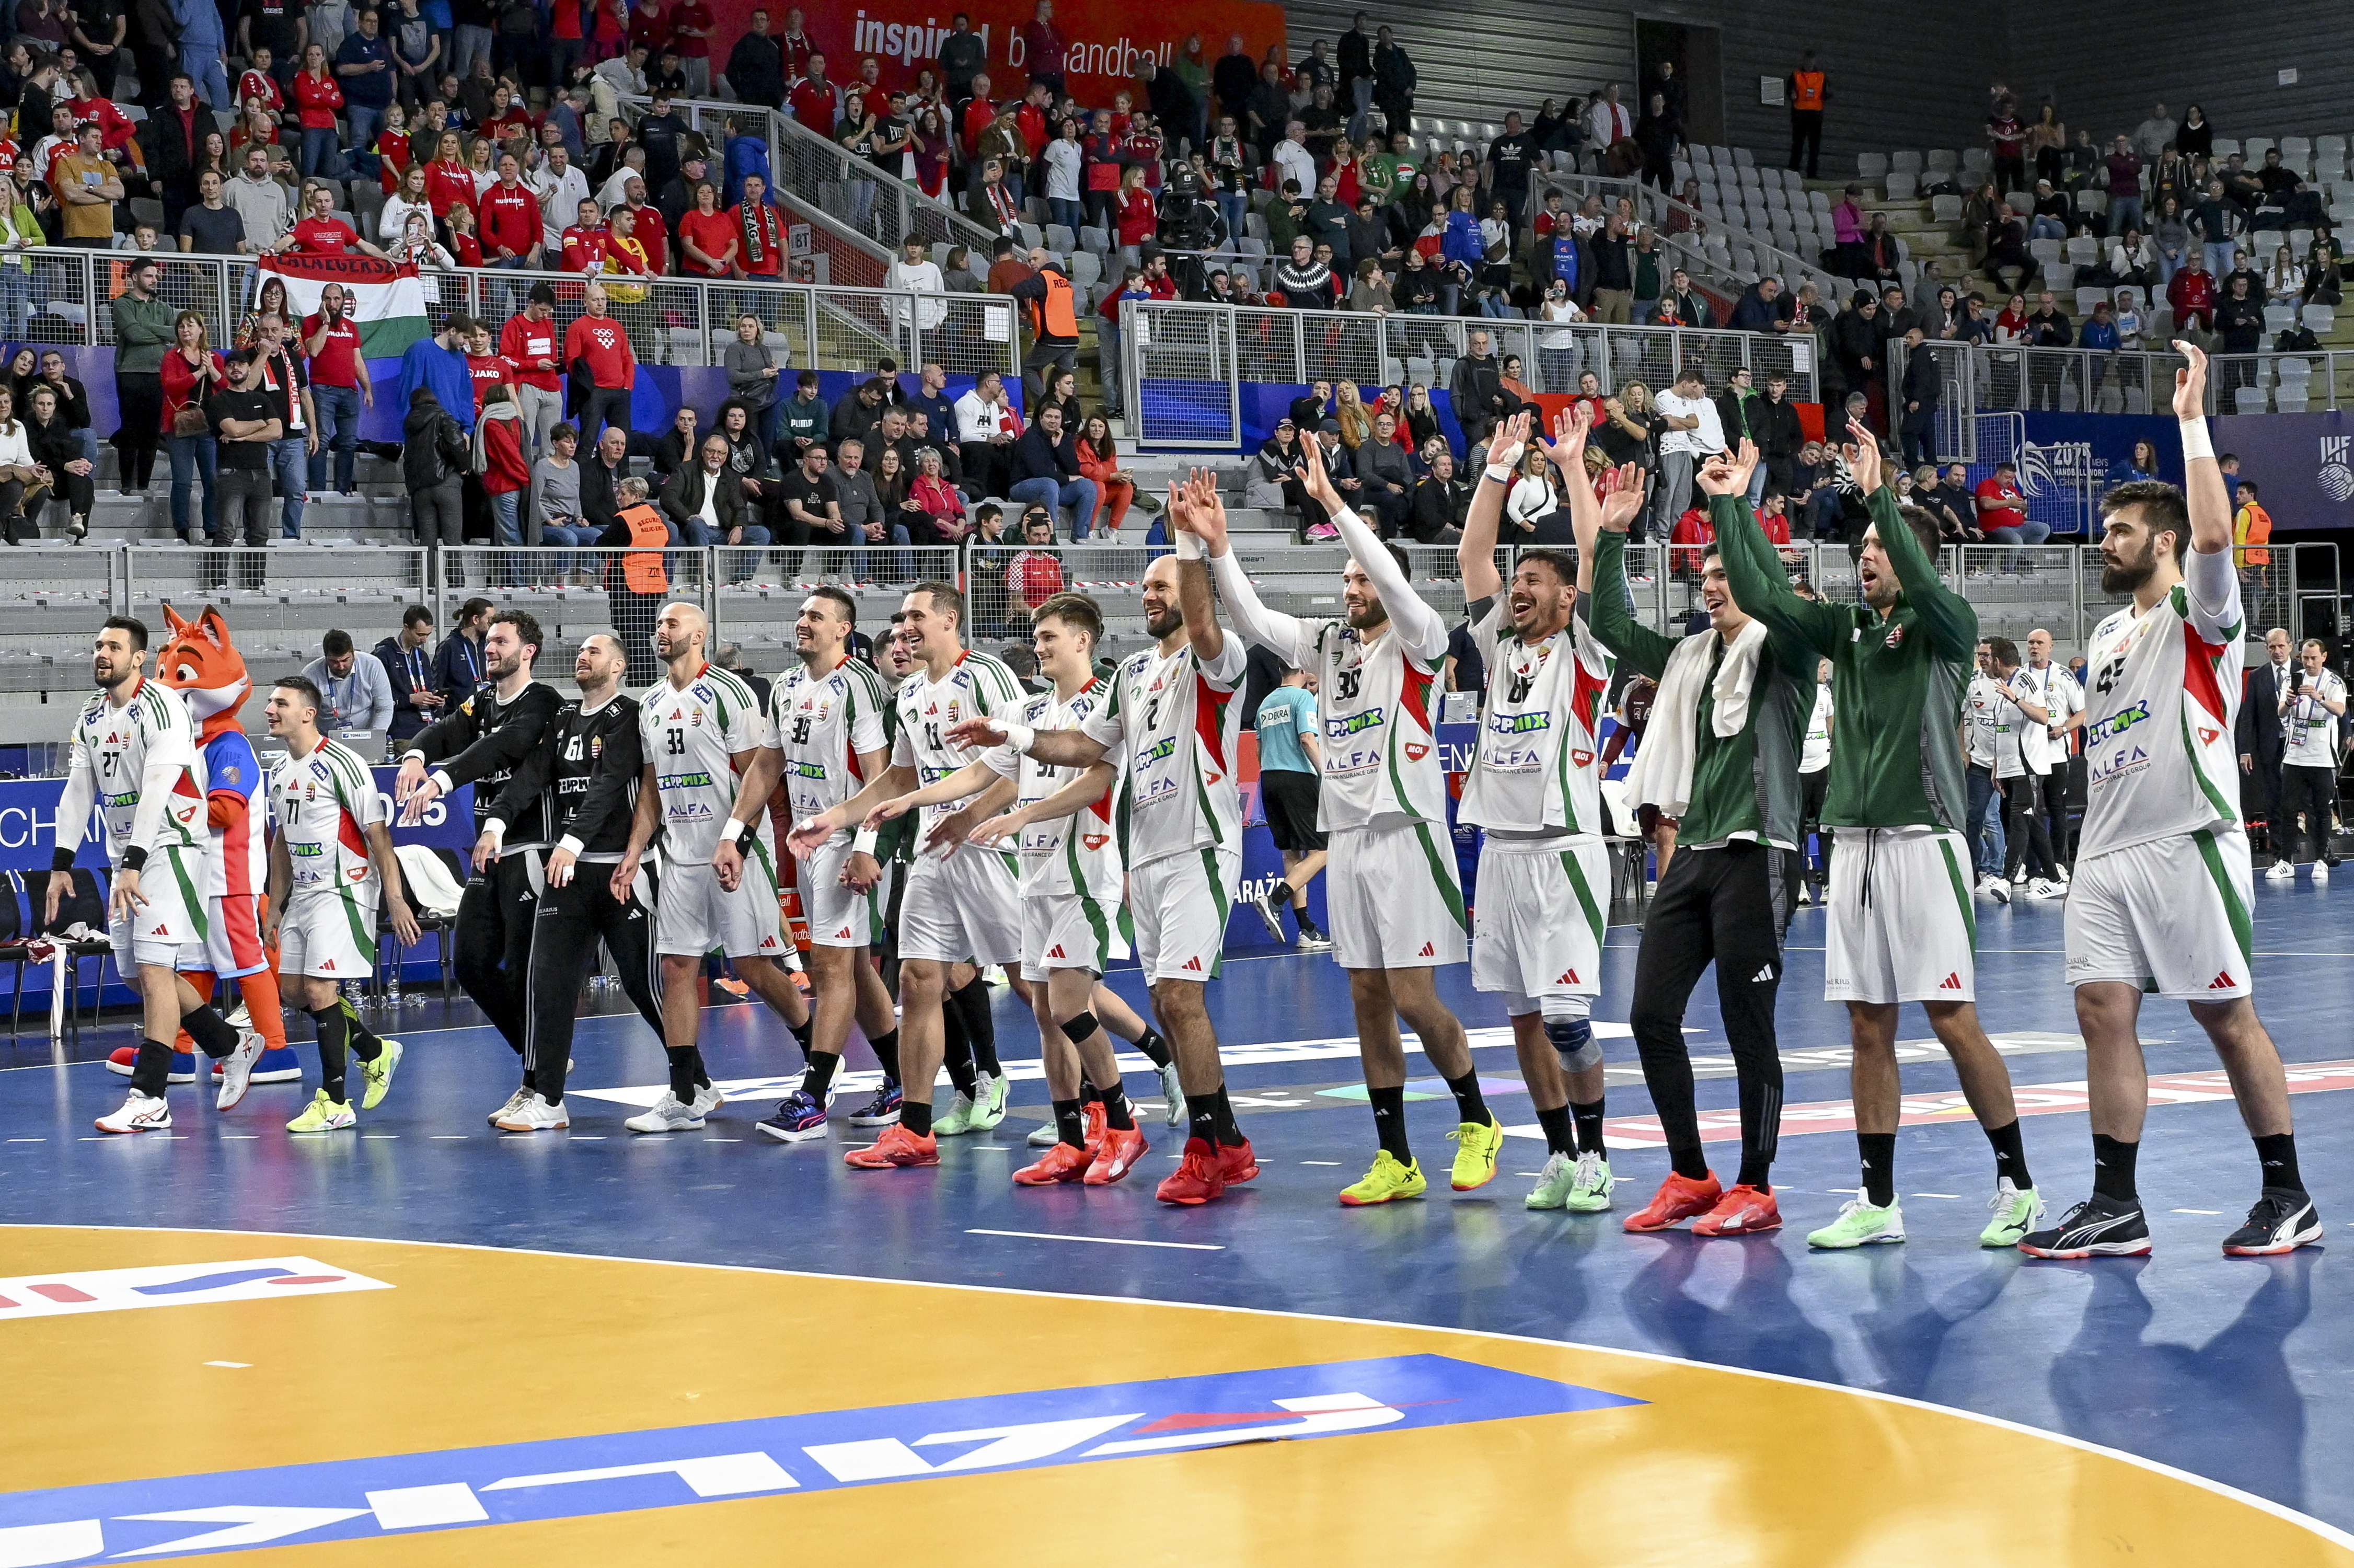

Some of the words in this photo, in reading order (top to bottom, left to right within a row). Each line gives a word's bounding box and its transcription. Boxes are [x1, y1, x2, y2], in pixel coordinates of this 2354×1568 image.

[475, 370, 500, 378] JAKO
[2053, 468, 2087, 476] HANDBLL
[696, 686, 711, 702] JYSK
[1147, 698, 1158, 731] 2
[1268, 708, 1289, 721] DEKRA
[564, 733, 584, 761] 61
[666, 728, 685, 755] 33
[1574, 751, 1589, 762] MOL
[2092, 745, 2146, 781] ALFA
[102, 752, 120, 777] 27
[2129, 762, 2151, 775] GROUP
[313, 764, 327, 779] JYSK
[1162, 791, 1179, 803] GROUP
[179, 809, 191, 819] MOL
[668, 802, 711, 816] ALFA
[349, 868, 363, 877] MOL
